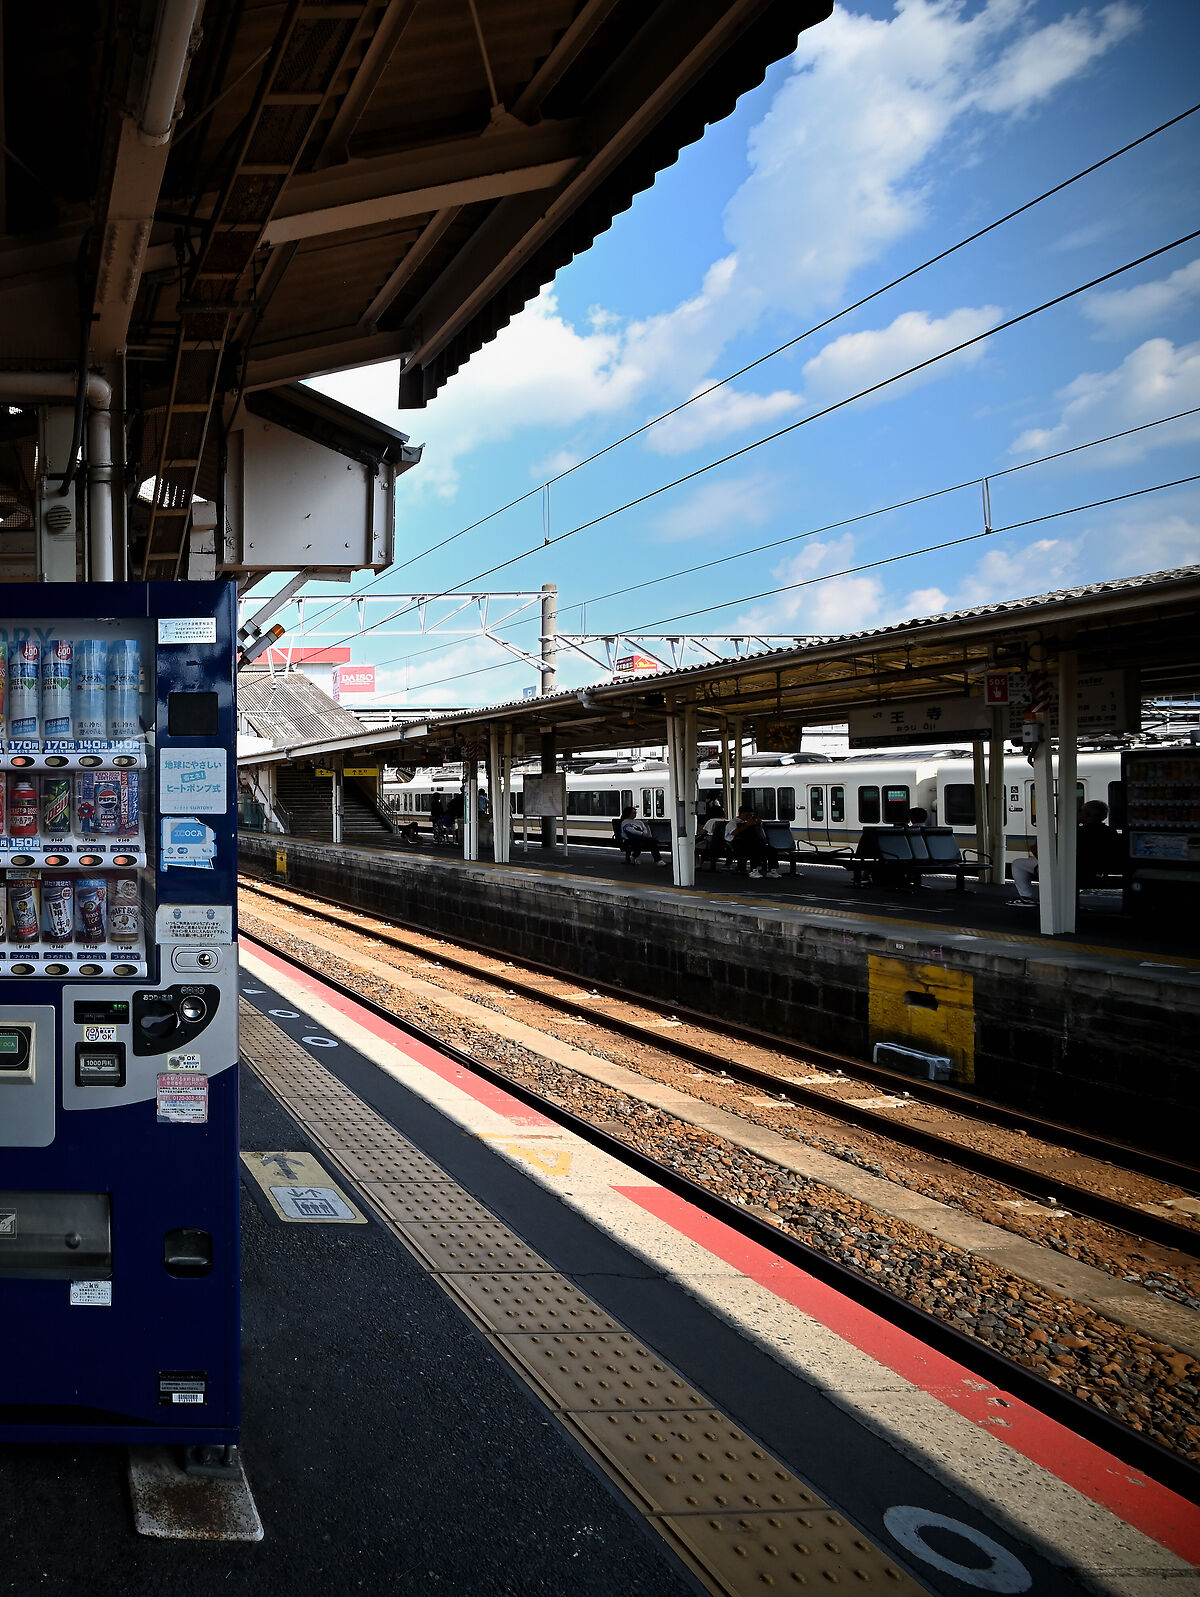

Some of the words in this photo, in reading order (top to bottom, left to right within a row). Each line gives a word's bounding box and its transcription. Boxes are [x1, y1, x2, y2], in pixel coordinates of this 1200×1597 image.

[24, 648, 38, 656] 600
[58, 648, 71, 656] 600
[341, 674, 374, 683] DAISO
[988, 678, 1005, 686] SOS
[890, 706, 942, 723] 王寺
[10, 741, 39, 750] 170円
[46, 741, 75, 750] 170円
[79, 741, 108, 750] 140円
[164, 760, 222, 769] 地球にやさしい
[167, 784, 222, 793] ヒートポンプ式
[11, 838, 39, 846] 150円
